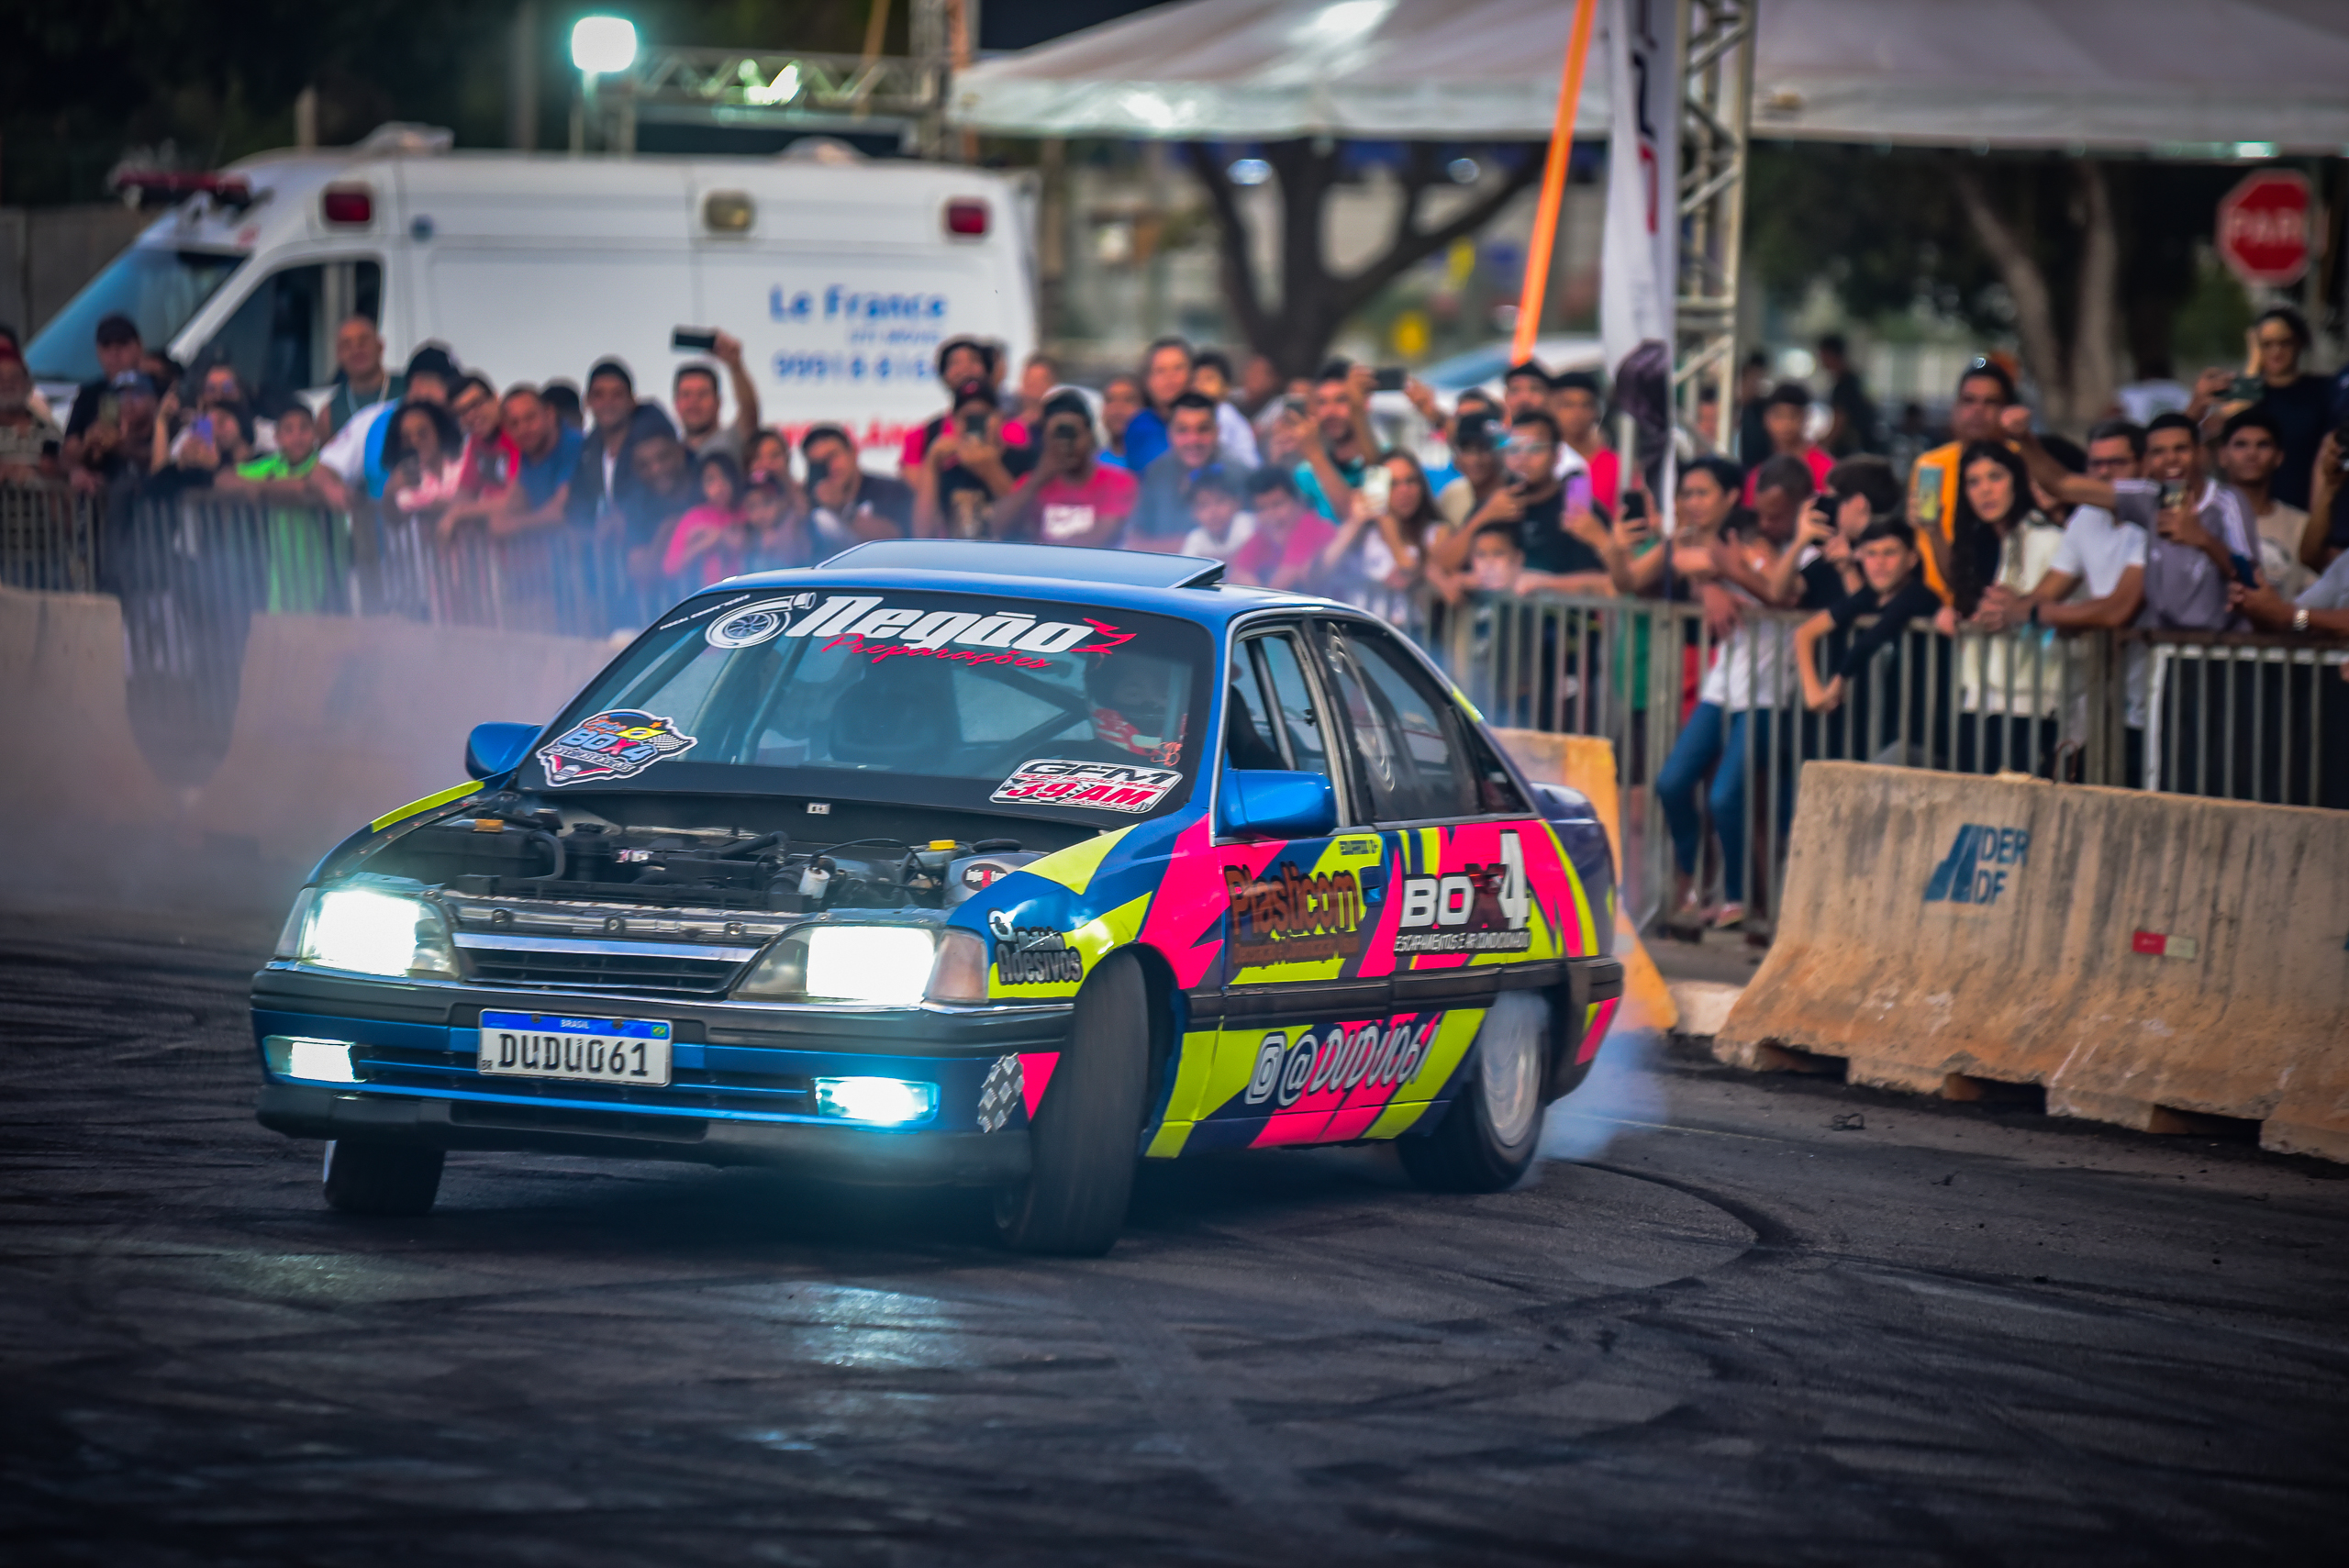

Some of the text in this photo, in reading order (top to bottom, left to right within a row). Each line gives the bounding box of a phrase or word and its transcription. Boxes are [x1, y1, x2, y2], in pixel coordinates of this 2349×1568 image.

[770, 284, 946, 320] Le France
[821, 632, 1052, 669] Preparações
[560, 728, 654, 762] BOX4
[1021, 763, 1178, 785] GFM
[1006, 780, 1158, 806] 39 AM
[1979, 826, 2031, 868] DER
[1224, 861, 1360, 938] Plasticom
[1398, 832, 1527, 930] BOX4
[1973, 869, 2009, 906] DF
[560, 1019, 591, 1029] BRASIL
[497, 1033, 649, 1077] DUDU061
